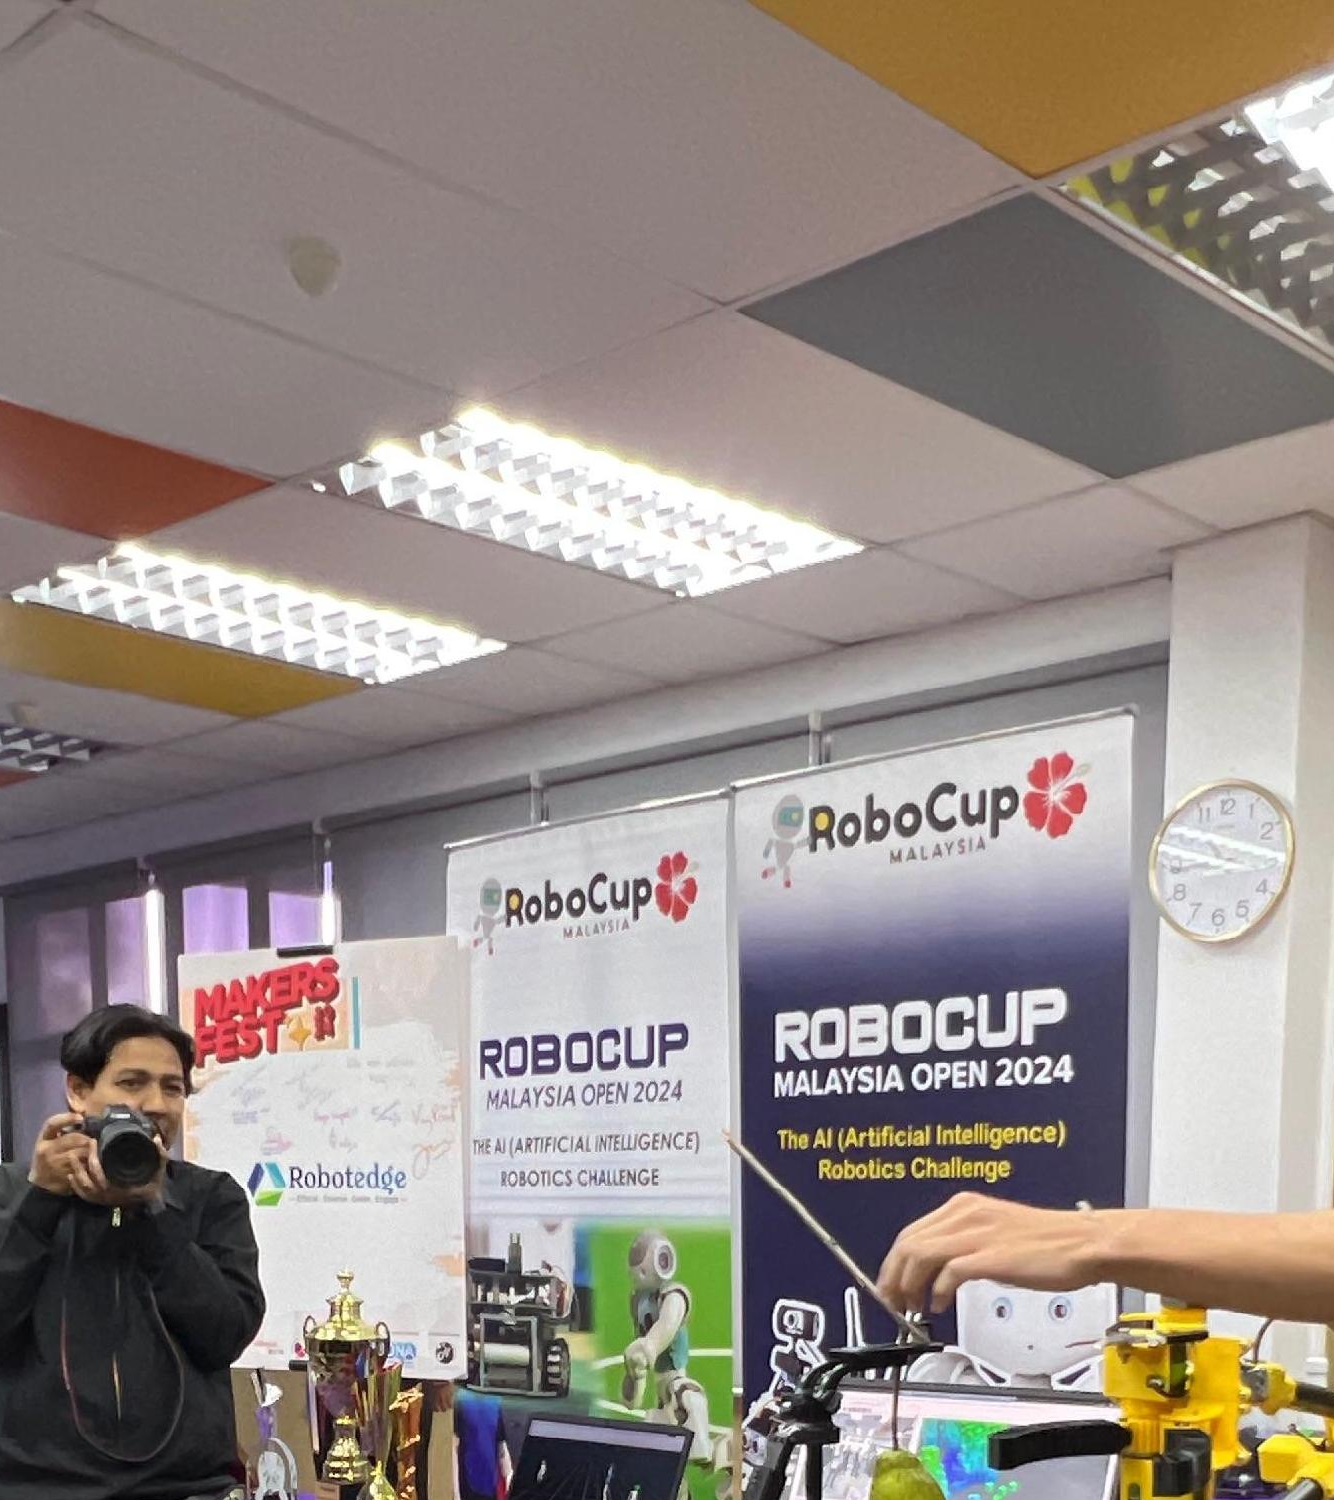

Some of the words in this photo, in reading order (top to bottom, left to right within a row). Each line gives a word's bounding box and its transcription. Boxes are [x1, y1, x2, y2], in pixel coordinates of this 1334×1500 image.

[808, 782, 1018, 853] RoboCup
[1198, 806, 1211, 823] 11
[1219, 797, 1236, 815] 12
[1260, 822, 1274, 840] 2
[890, 835, 986, 864] MALAYSIA
[505, 872, 652, 928] RoboCup
[1173, 883, 1186, 901] 8
[1255, 879, 1268, 895] 4
[1189, 902, 1203, 920] 7
[1211, 908, 1226, 927] 6
[1235, 900, 1250, 918] 5
[563, 918, 630, 939] MALAYSIA
[194, 957, 340, 1028] MAKERS
[194, 1009, 288, 1069] FEST
[774, 988, 1067, 1063] ROBOCUP
[480, 1023, 689, 1080] ROBOCUP
[773, 1064, 904, 1098] MALAYSIA
[911, 1060, 988, 1090] OPEN
[995, 1054, 1074, 1087] 2024
[486, 1085, 576, 1111] MALAYSIA
[581, 1081, 629, 1106] OPEN
[633, 1080, 683, 1103] 2024
[473, 1138, 491, 1155] THE
[494, 1138, 506, 1154] AI
[509, 1135, 591, 1158] (ARTIFICIAL
[595, 1131, 700, 1154] INTELLIGENCE)
[778, 1129, 809, 1150] The
[813, 1128, 832, 1149] AI
[838, 1125, 931, 1152] (Artificial
[936, 1120, 1066, 1150] Intelligence)
[289, 1162, 407, 1194] Robotedge
[500, 1169, 572, 1188] ROBOTICS
[577, 1168, 660, 1187] CHALLENGE
[818, 1158, 905, 1180] Robotics
[911, 1156, 1011, 1184] Challenge
